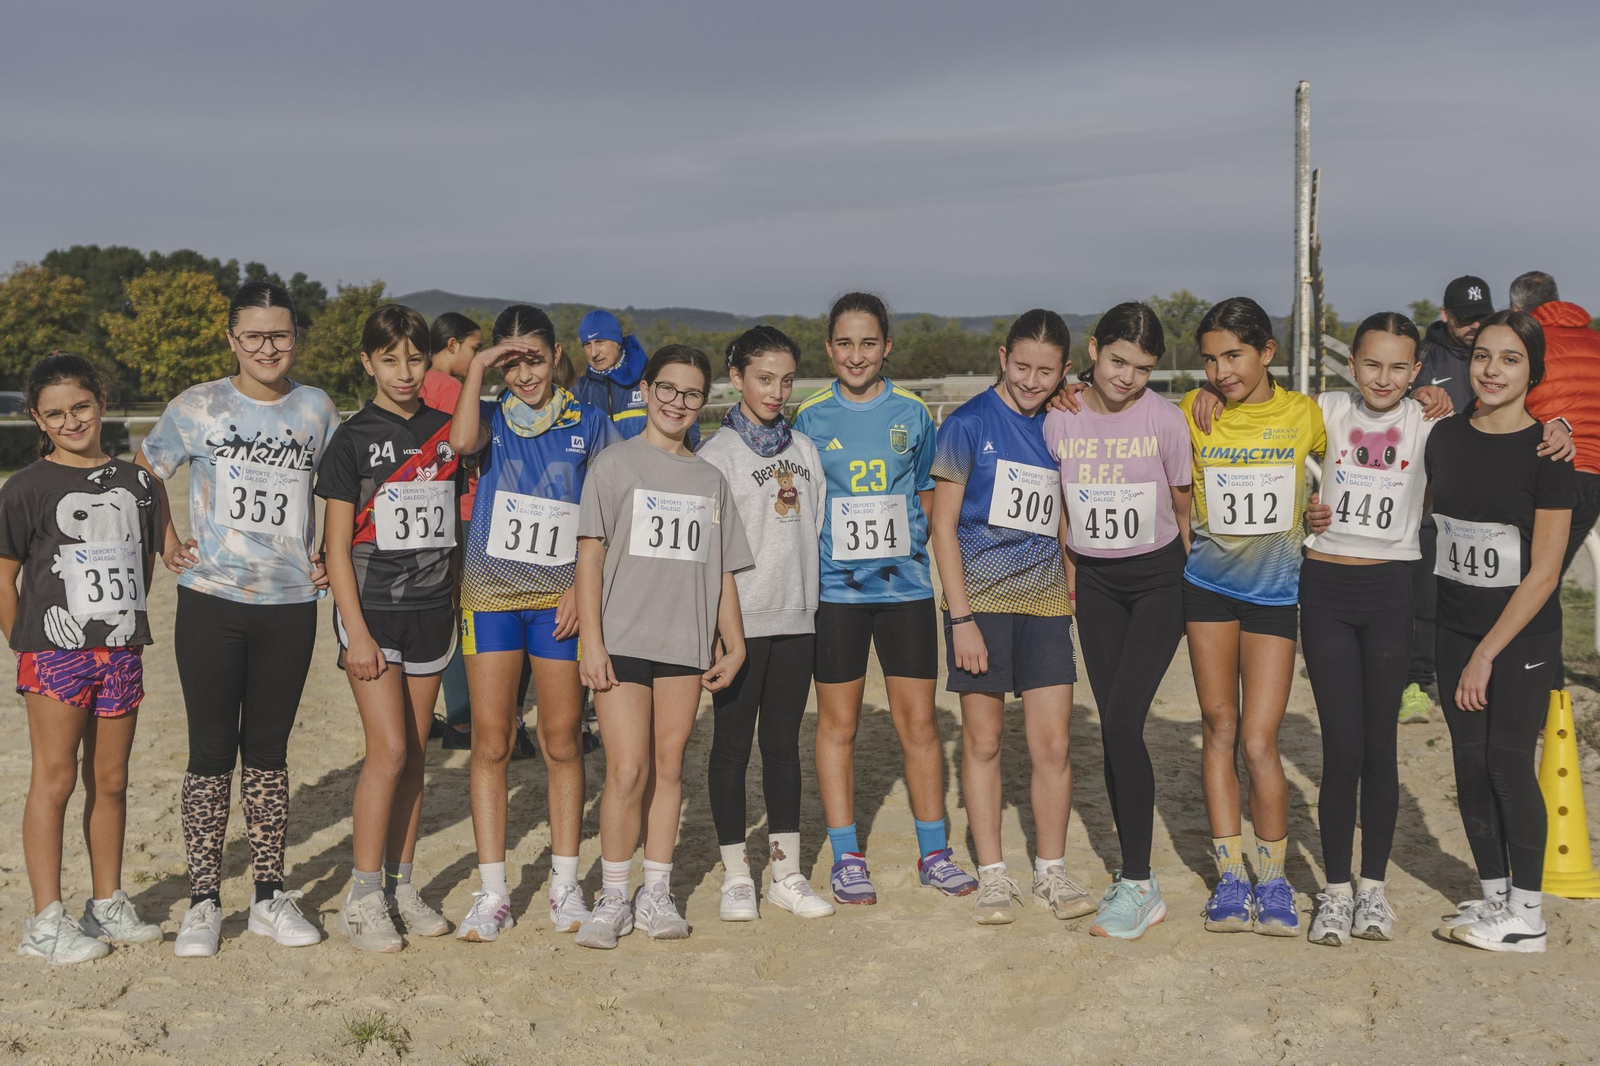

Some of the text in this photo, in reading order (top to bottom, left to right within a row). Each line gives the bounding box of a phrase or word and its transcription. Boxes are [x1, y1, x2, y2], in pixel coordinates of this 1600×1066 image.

[1467, 286, 1482, 301] NY
[210, 441, 314, 471] SUNSHINE
[369, 440, 396, 468] 24
[1057, 436, 1158, 459] NICE TEAM
[244, 475, 268, 484] GALEGO
[245, 468, 271, 477] DEPORTE
[751, 459, 811, 487] Bear Mood
[849, 459, 887, 492] 23
[1021, 478, 1041, 486] GALEGO
[1022, 471, 1043, 480] DEPORTE
[1078, 463, 1126, 485] B.F.F.
[1349, 472, 1375, 482] DEPORTE
[1349, 479, 1373, 488] GALEGO
[229, 486, 288, 526] 353
[519, 508, 543, 517] GALEGO
[660, 499, 682, 507] DEPORTE
[1007, 487, 1054, 526] 309
[1222, 492, 1278, 526] 312
[1335, 490, 1394, 530] 448
[394, 506, 445, 540] 352
[648, 515, 701, 552] 310
[846, 518, 897, 551] 354
[1085, 507, 1140, 540] 450
[1453, 525, 1477, 535] DEPORTE
[1453, 531, 1475, 540] GALEGO
[504, 518, 560, 558] 311
[1448, 541, 1500, 579] 449
[85, 567, 138, 603] 355
